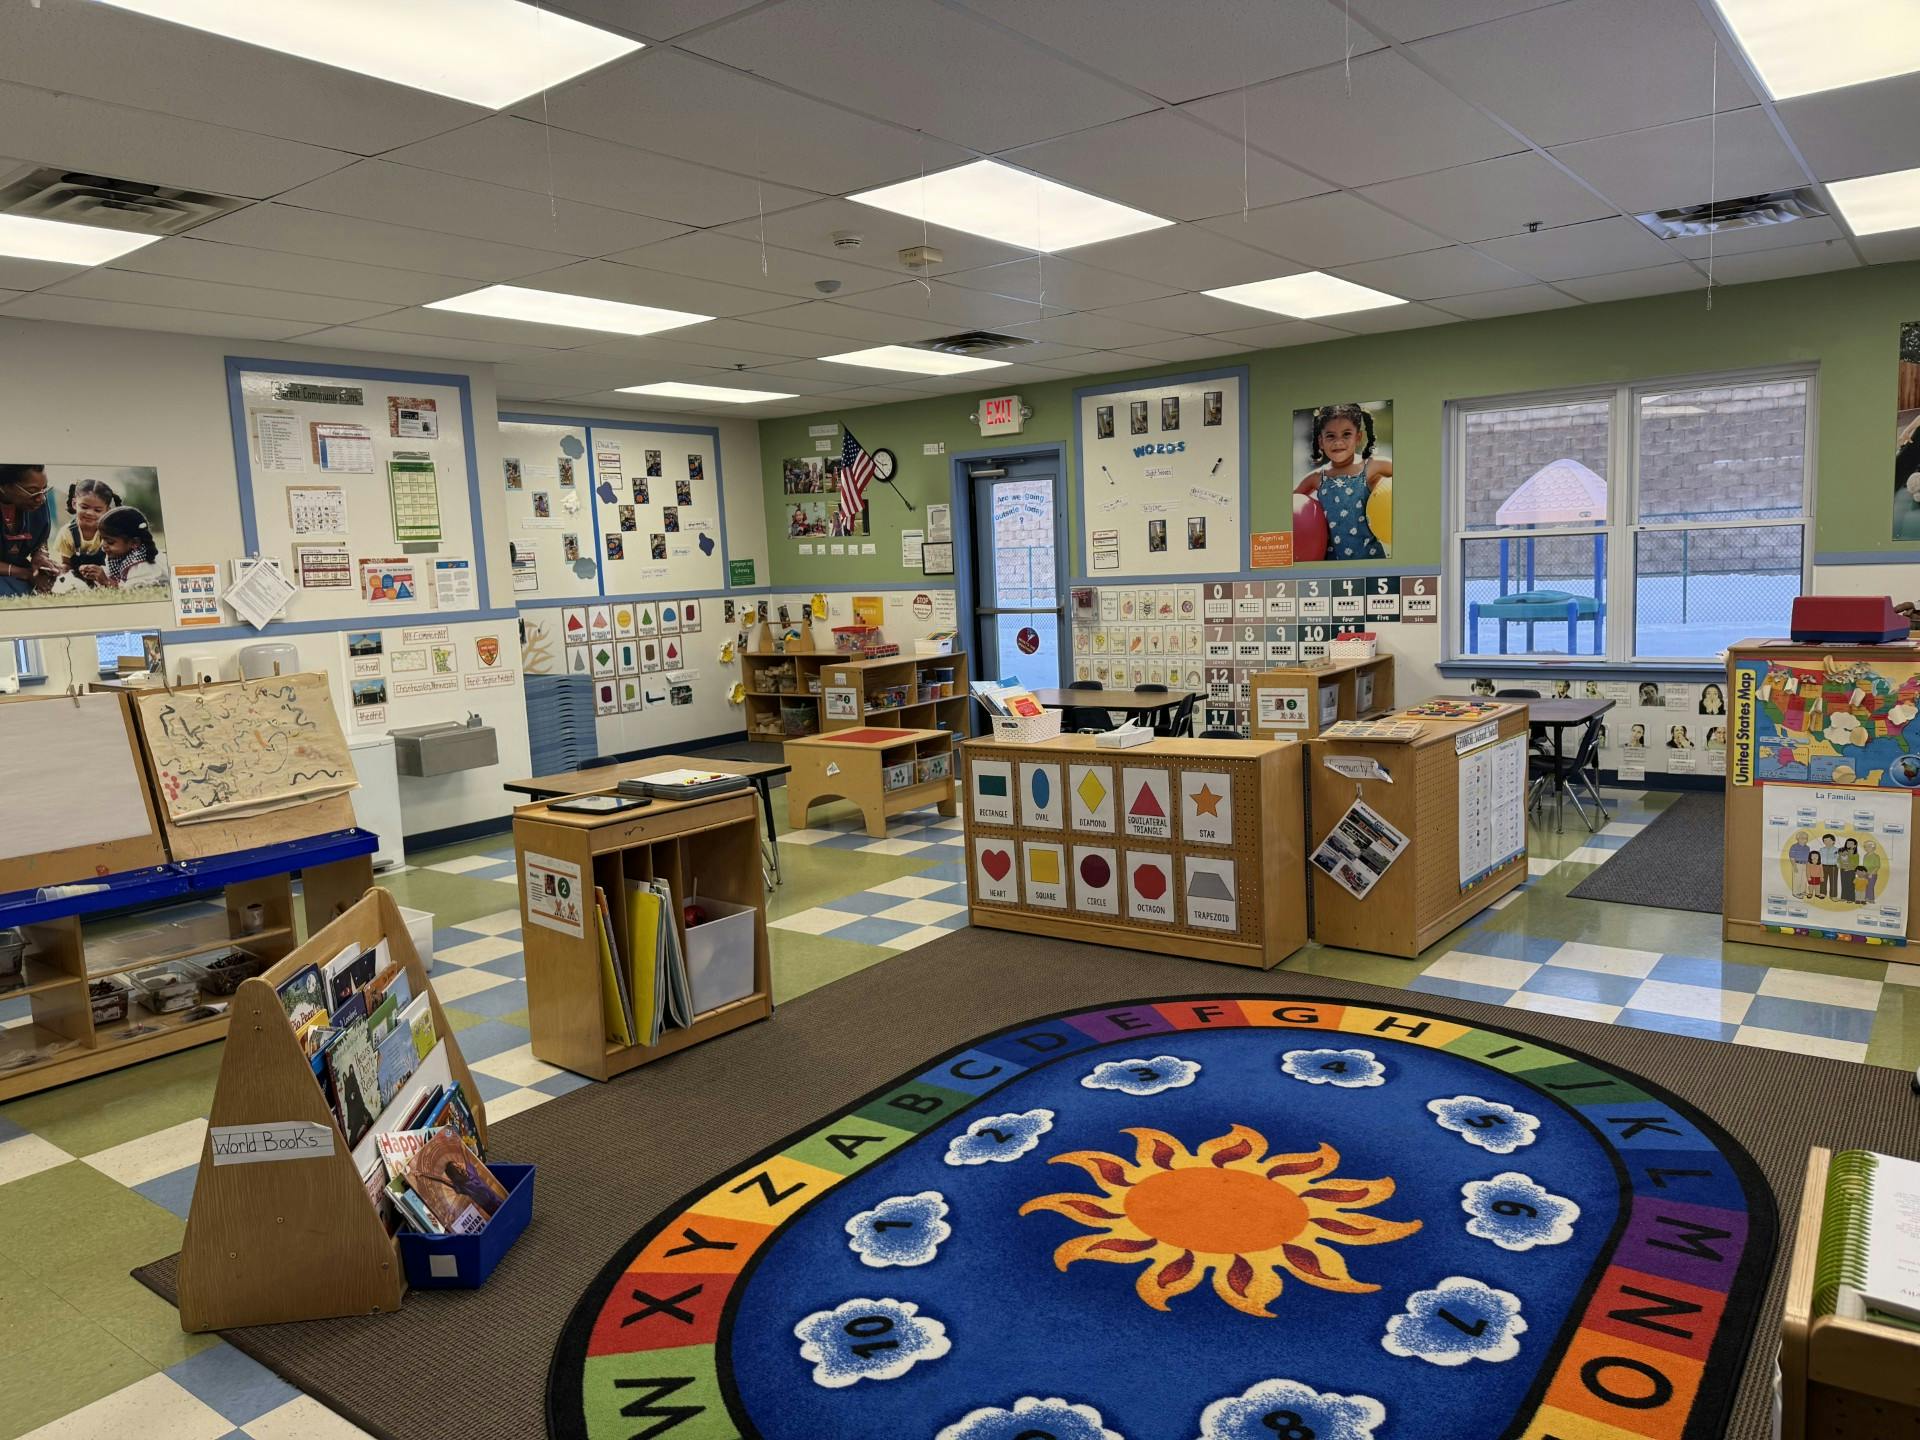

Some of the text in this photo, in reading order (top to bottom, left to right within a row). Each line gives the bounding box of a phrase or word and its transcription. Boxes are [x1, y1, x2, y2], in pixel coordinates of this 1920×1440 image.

[986, 399, 1012, 424] EXIT
[1133, 441, 1185, 458] WORDS
[1024, 492, 1045, 503] going
[994, 503, 1045, 521] outside today
[1259, 535, 1284, 543] Cognitive
[1254, 543, 1289, 552] Development
[1213, 584, 1222, 599] 0
[1244, 583, 1253, 599] 1
[1276, 582, 1286, 598] 2
[1308, 581, 1319, 597] 3
[1342, 580, 1353, 596] 4
[1377, 578, 1388, 595] 5
[1413, 578, 1425, 595] 6
[1214, 626, 1223, 642] 7
[1244, 626, 1255, 642] 8
[1276, 626, 1286, 641] 9
[1304, 625, 1324, 641] 10
[1211, 668, 1229, 684] 12
[1211, 710, 1229, 725] 17
[1736, 672, 1755, 784] United States Map
[1827, 792, 1856, 801] Familia
[979, 808, 1008, 819] RECTANGLE
[1035, 813, 1049, 821] OVAL
[1079, 818, 1107, 828] DIAMOND
[1127, 816, 1168, 828] EQUILATERAL
[1133, 824, 1163, 836] TRIANGLE
[1199, 829, 1215, 839] STAR
[561, 881, 568, 895] 2
[989, 889, 1007, 898] HEART
[1035, 891, 1057, 901] SQUARE
[1086, 897, 1107, 907] CIRCLE
[1137, 903, 1166, 915] OCTAGON
[1193, 910, 1230, 923] TRAPEZOID
[1110, 1013, 1152, 1030] E
[1192, 1005, 1225, 1023] F
[1271, 1006, 1319, 1024] G
[1373, 1016, 1431, 1039] H
[1019, 1031, 1067, 1052] D
[949, 1058, 1000, 1080] C
[1130, 1068, 1159, 1081] 3
[1322, 1062, 1347, 1073] 4
[1543, 1079, 1617, 1092] J
[888, 1091, 943, 1115] B
[1465, 1115, 1505, 1128] 5
[1606, 1117, 1683, 1140] K
[213, 1132, 257, 1155] World
[976, 1129, 1013, 1143] 2
[381, 1132, 425, 1157] Happy
[825, 1129, 886, 1160] A
[1646, 1168, 1712, 1188] L
[730, 1170, 806, 1207] Z
[1492, 1201, 1537, 1218] 6
[874, 1221, 912, 1233] 1
[664, 1226, 735, 1257] Y
[1646, 1216, 1732, 1262] M
[622, 1286, 701, 1326] X
[1609, 1286, 1701, 1339] N
[1438, 1308, 1488, 1337] 7
[844, 1316, 899, 1359] 10
[1582, 1357, 1672, 1409] O
[1262, 1410, 1315, 1440] 8
